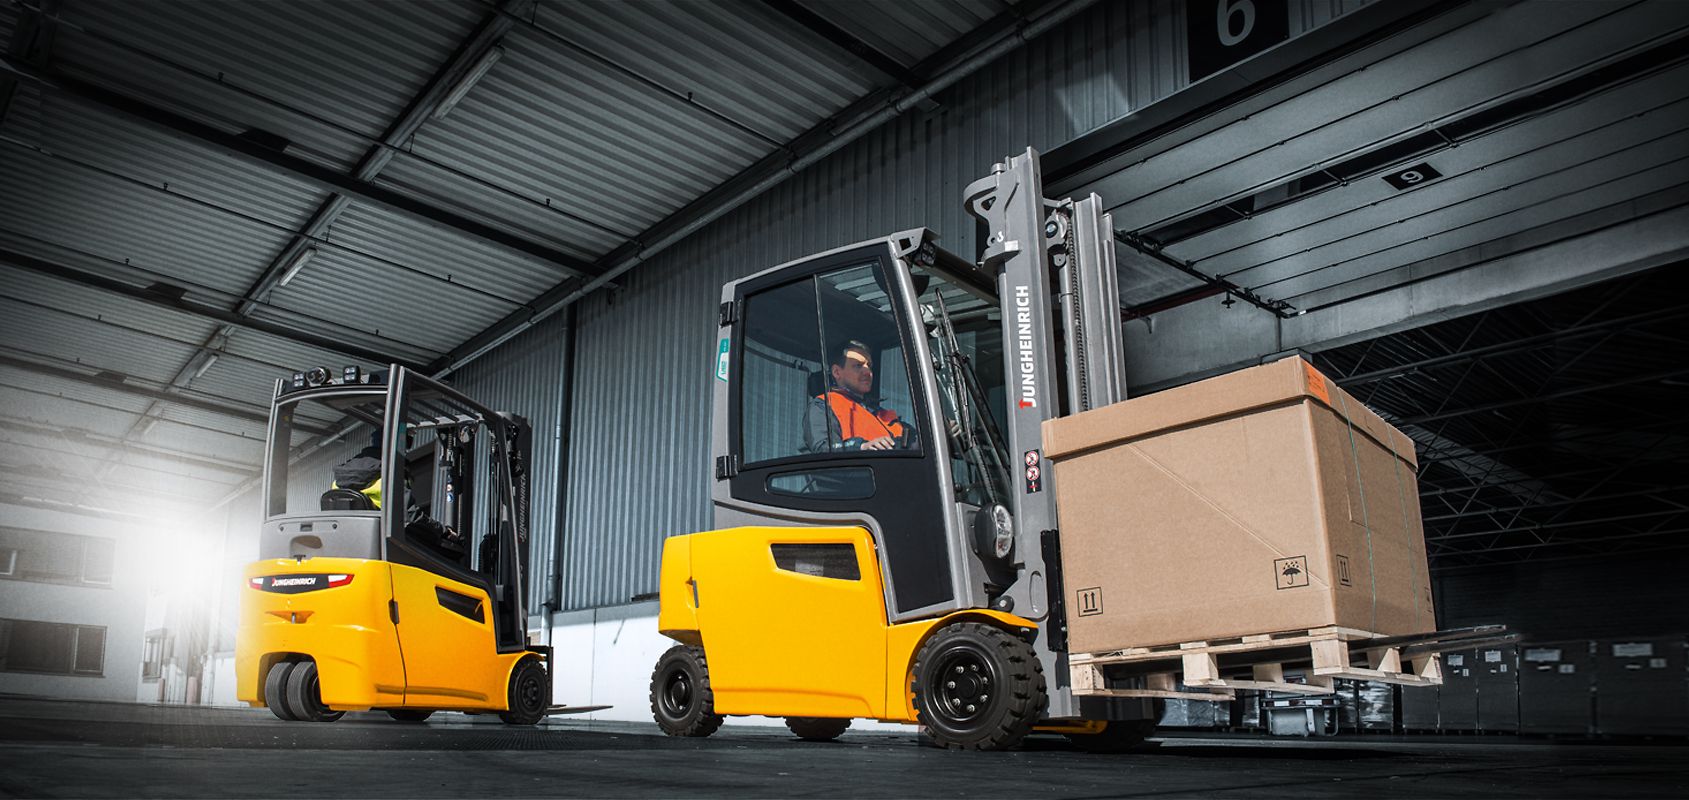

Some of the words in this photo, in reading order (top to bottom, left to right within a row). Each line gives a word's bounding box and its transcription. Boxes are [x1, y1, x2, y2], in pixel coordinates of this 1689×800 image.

[1217, 0, 1256, 46] 6
[1016, 285, 1037, 410] JUNGHEINRICH
[271, 577, 317, 587] JUNGHEINRICH
